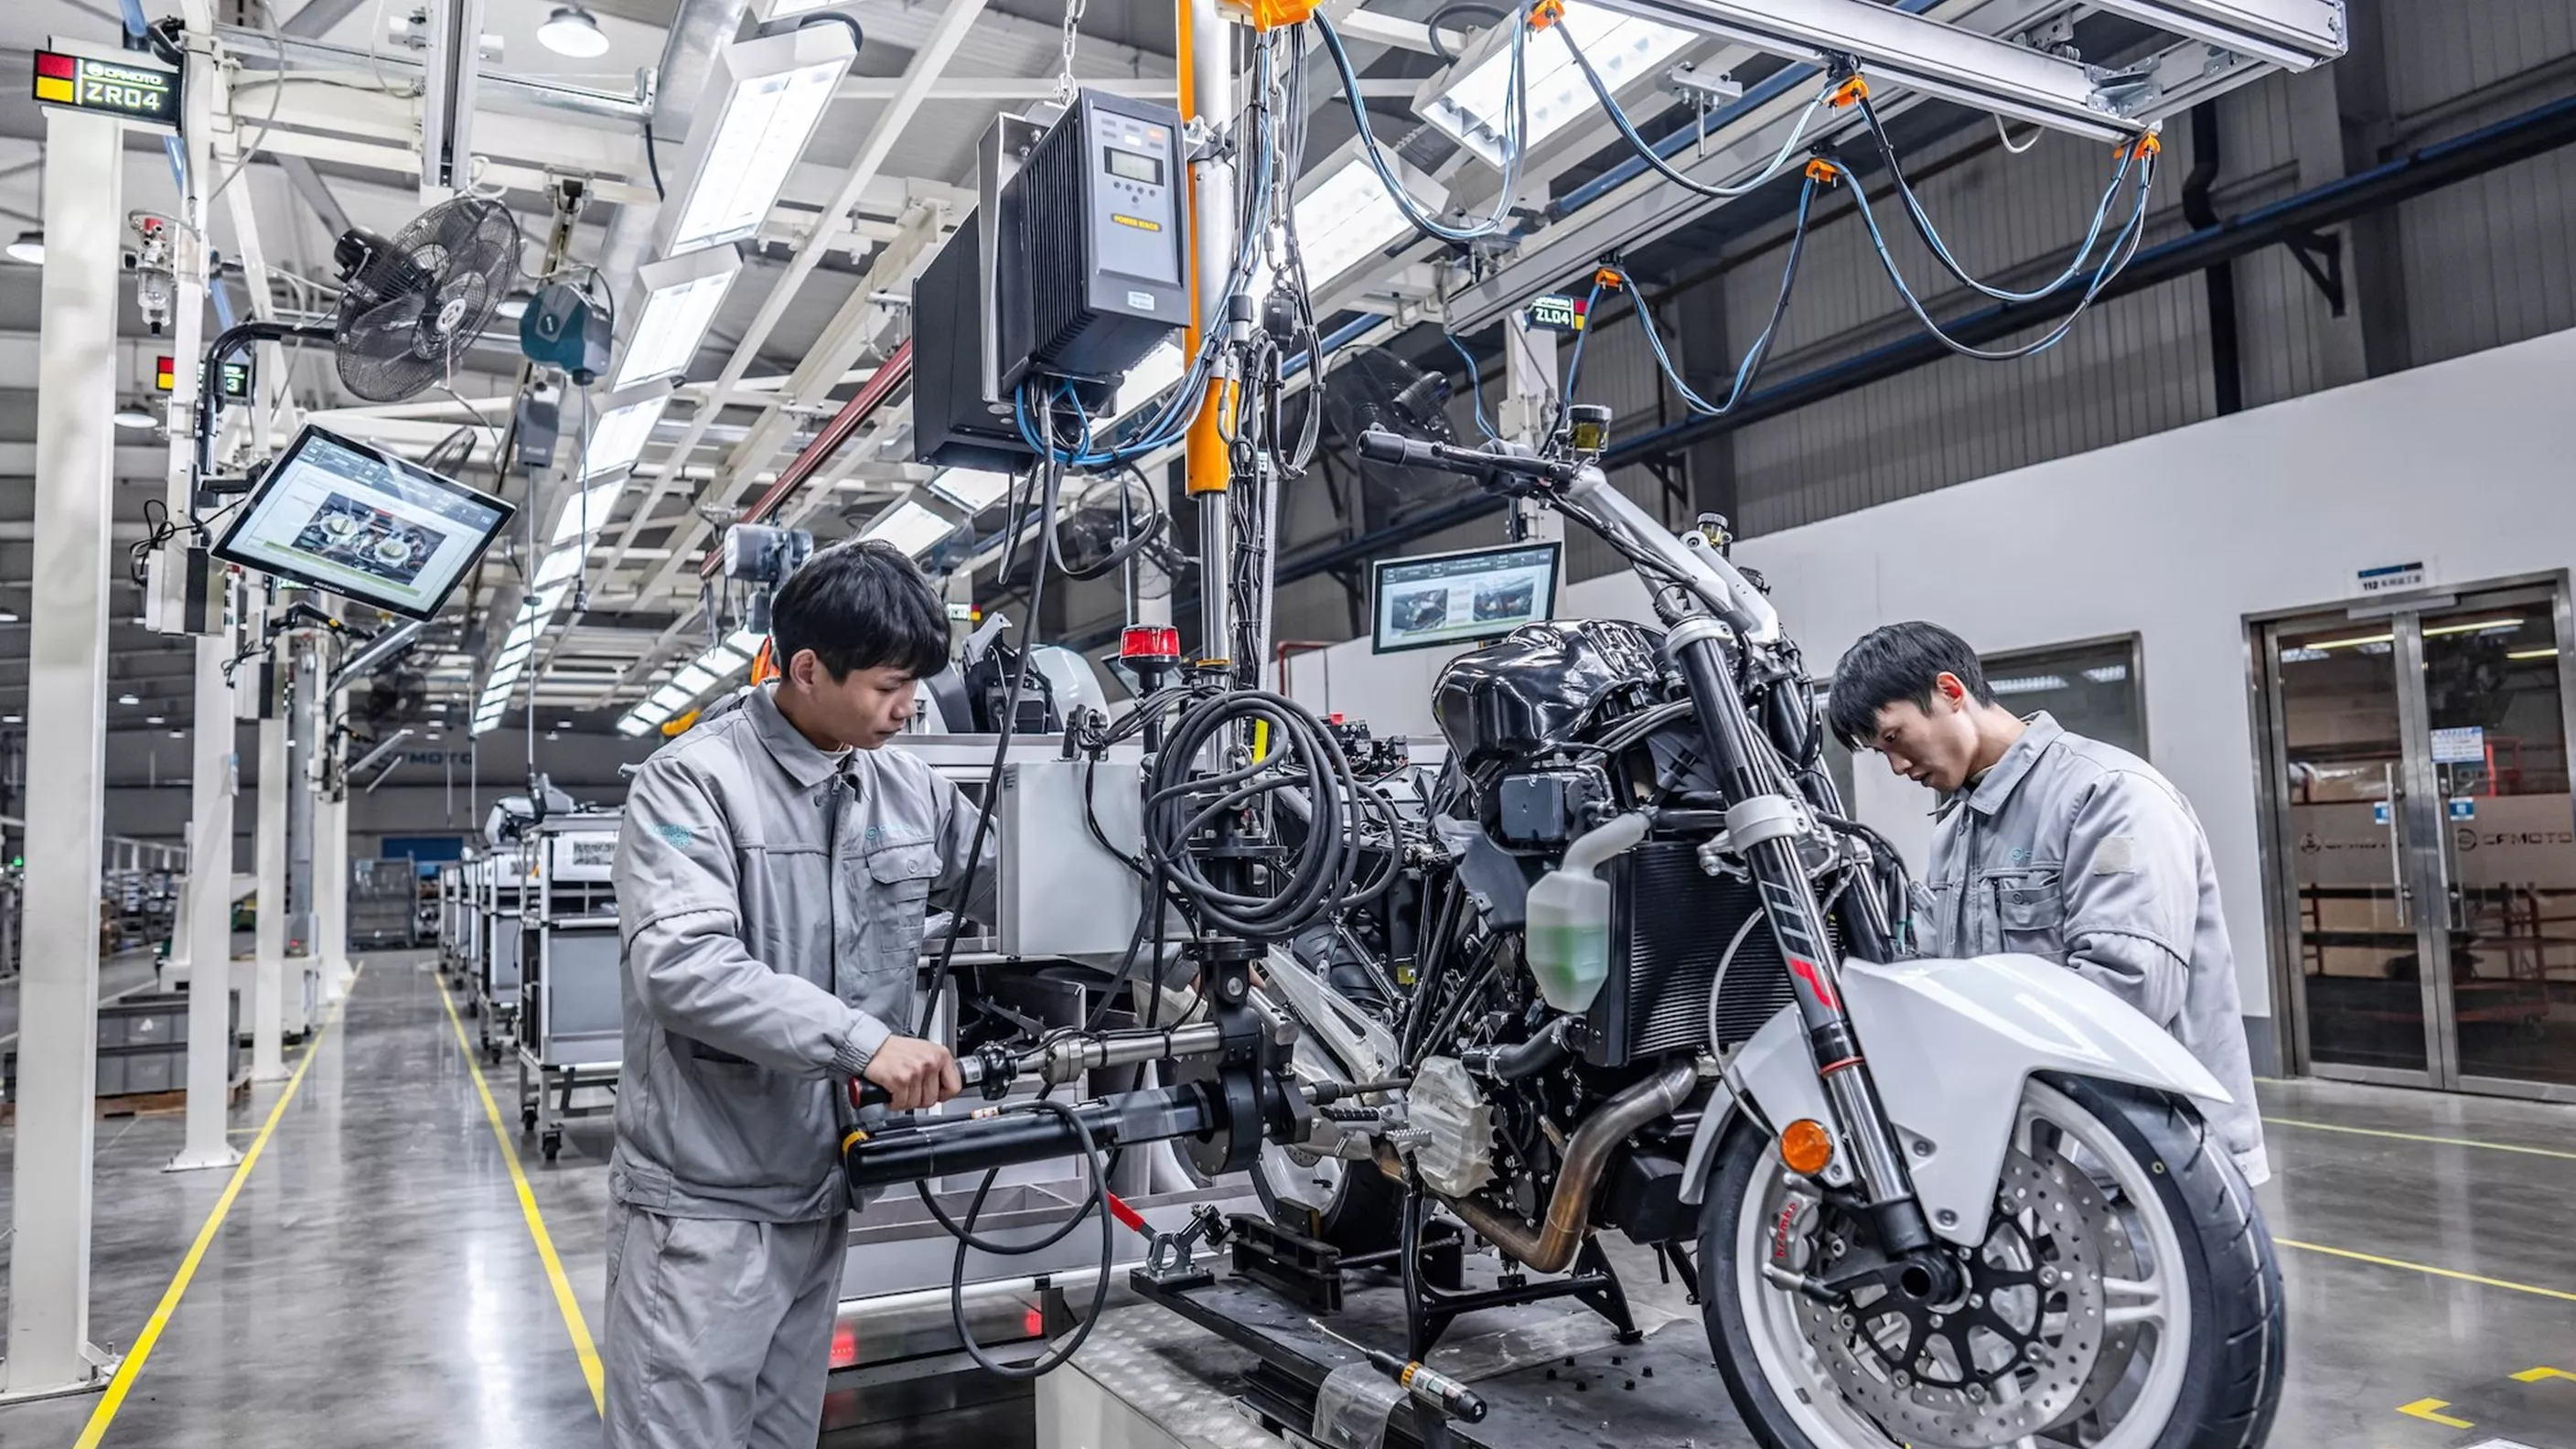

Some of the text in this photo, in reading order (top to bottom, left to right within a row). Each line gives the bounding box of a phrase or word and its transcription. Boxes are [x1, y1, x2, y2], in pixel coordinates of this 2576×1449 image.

[86, 82, 160, 111] ZR04
[1536, 307, 1570, 325] ZL04
[2363, 580, 2378, 591] 112
[2483, 832, 2573, 845] CFMOTO
[1775, 1201, 1798, 1258] brembo
[1474, 1404, 1484, 1416] 2
